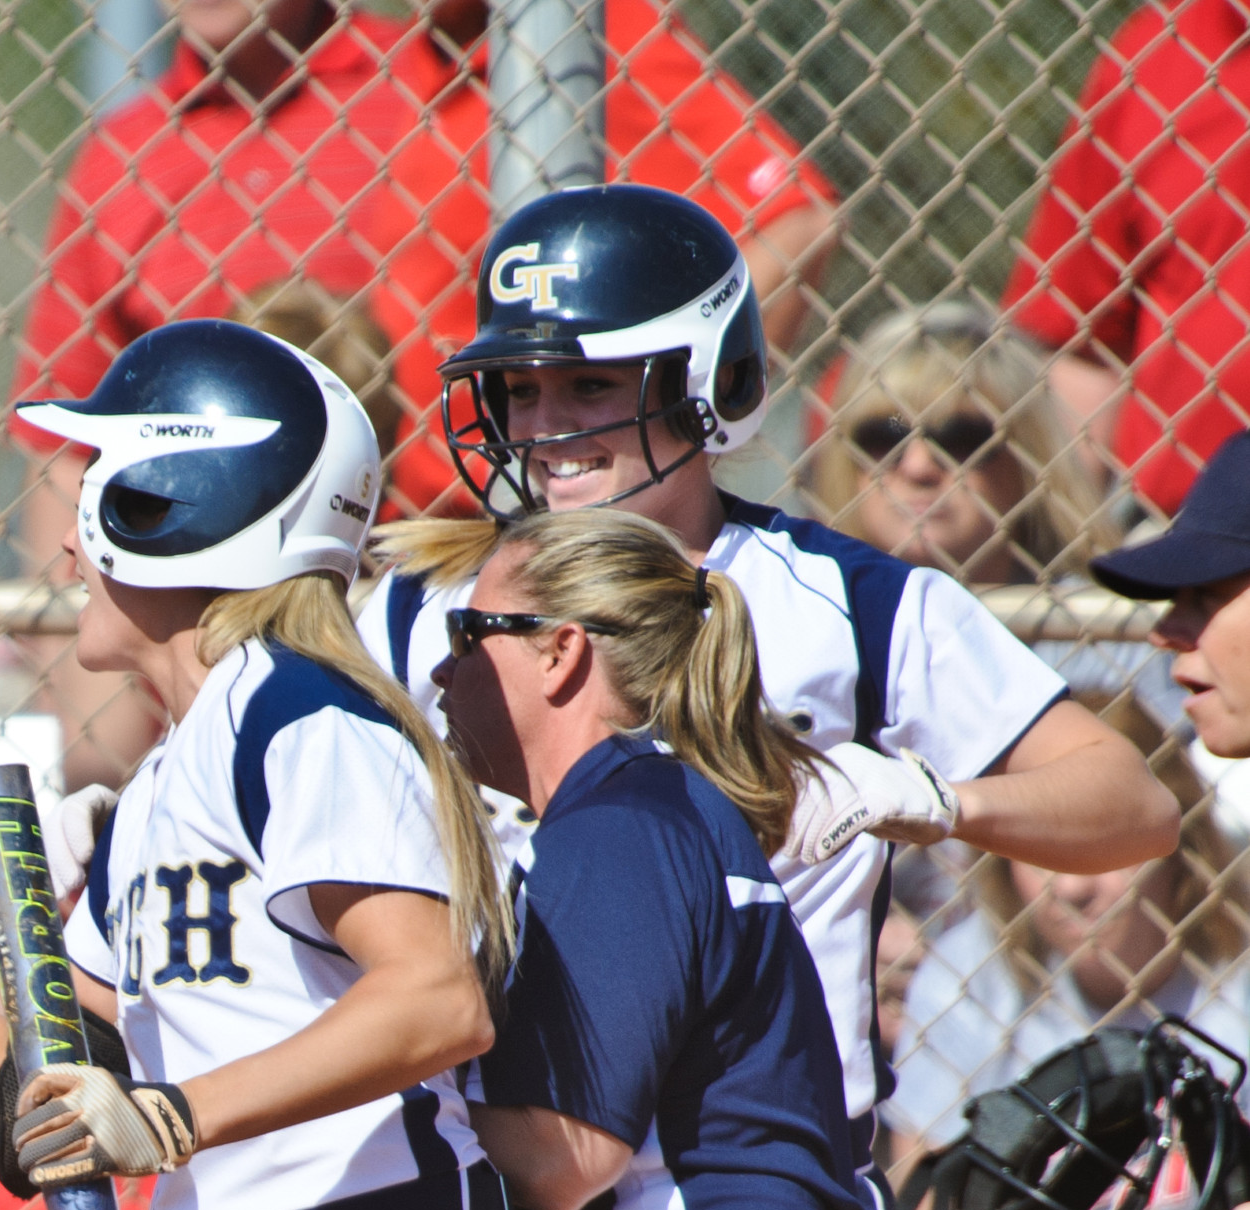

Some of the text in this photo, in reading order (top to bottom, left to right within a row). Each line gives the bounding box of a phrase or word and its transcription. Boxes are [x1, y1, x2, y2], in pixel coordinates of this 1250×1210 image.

[490, 242, 578, 310] GT
[709, 273, 740, 311] WORTH
[156, 424, 215, 439] WORTH
[829, 806, 869, 842] WORTH
[43, 1157, 95, 1181] WORTH
